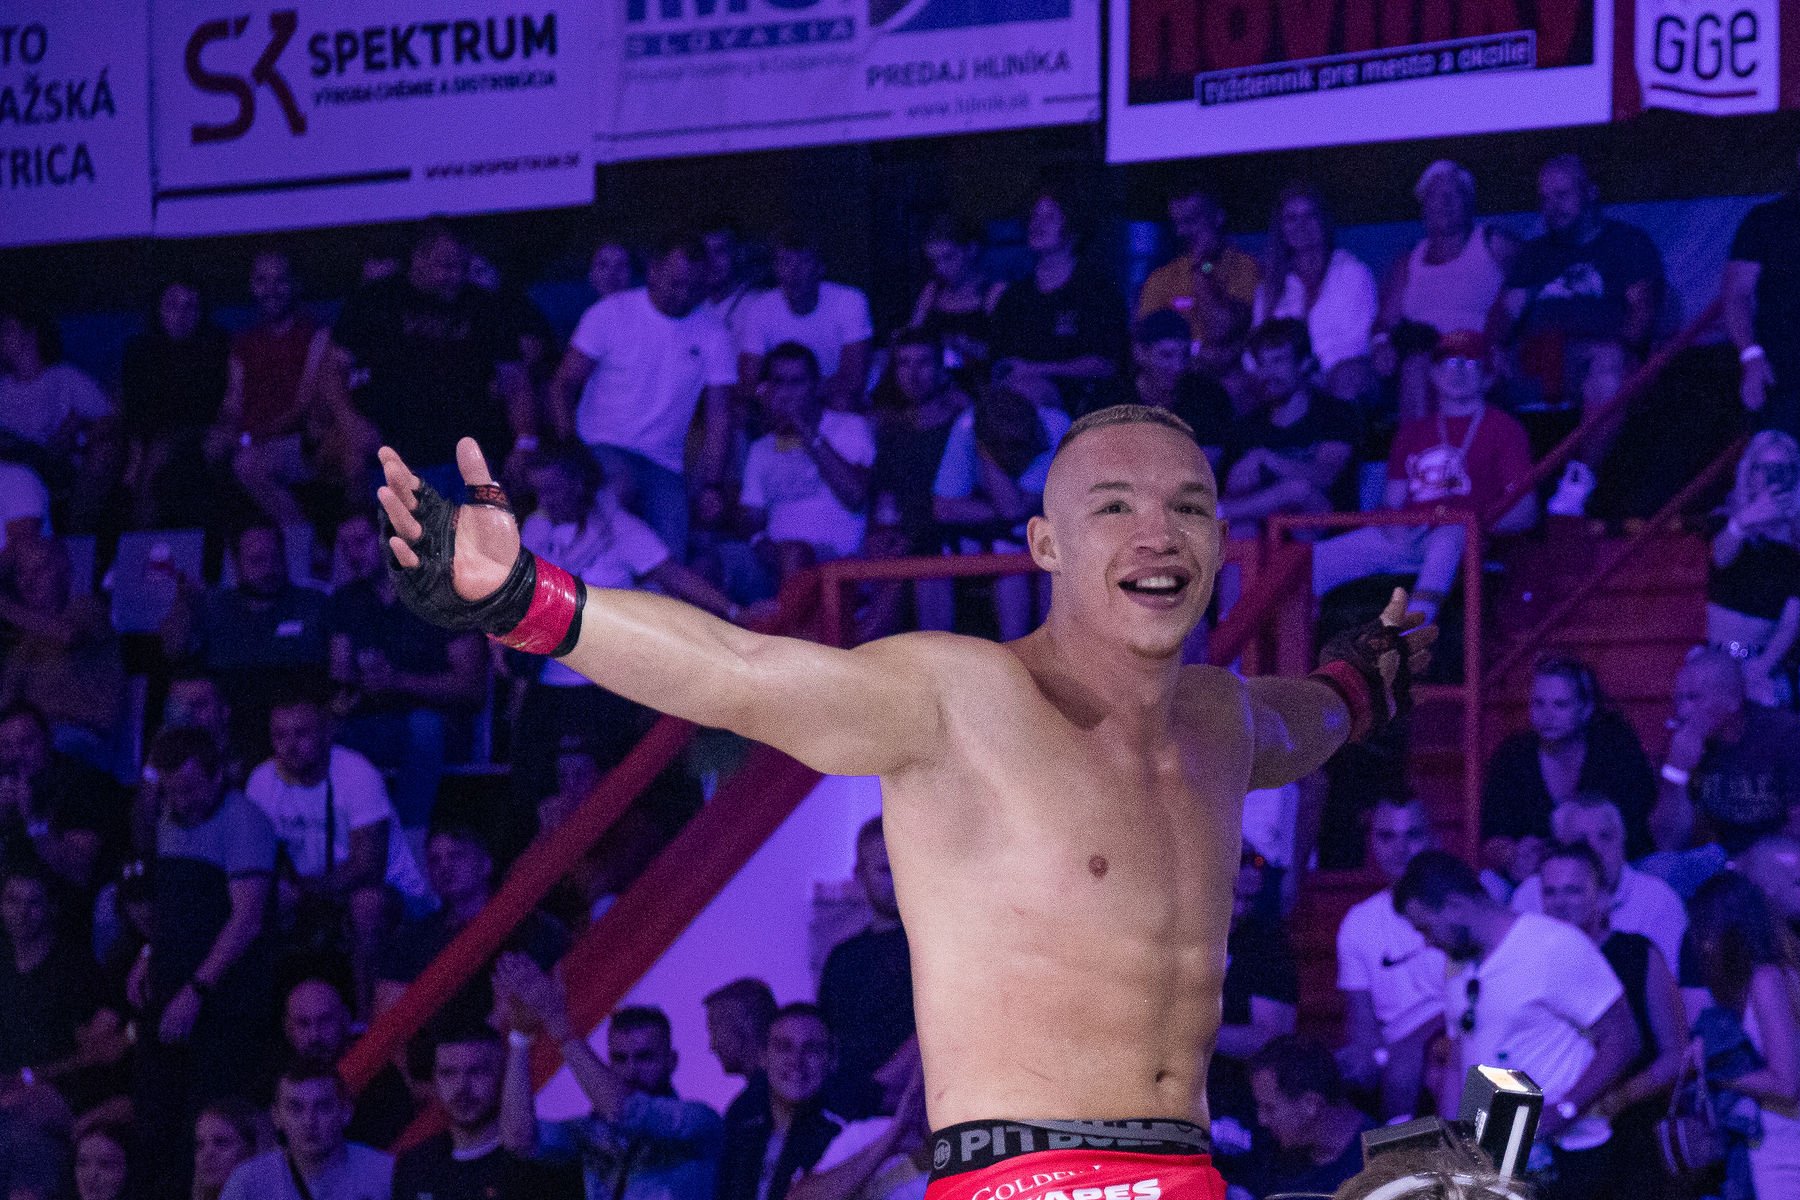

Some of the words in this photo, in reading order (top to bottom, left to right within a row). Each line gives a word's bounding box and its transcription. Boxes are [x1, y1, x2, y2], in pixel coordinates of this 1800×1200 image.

[308, 10, 558, 78] SPEKTRUM
[866, 60, 967, 89] PREDAJ
[960, 1126, 1034, 1162] PIT
